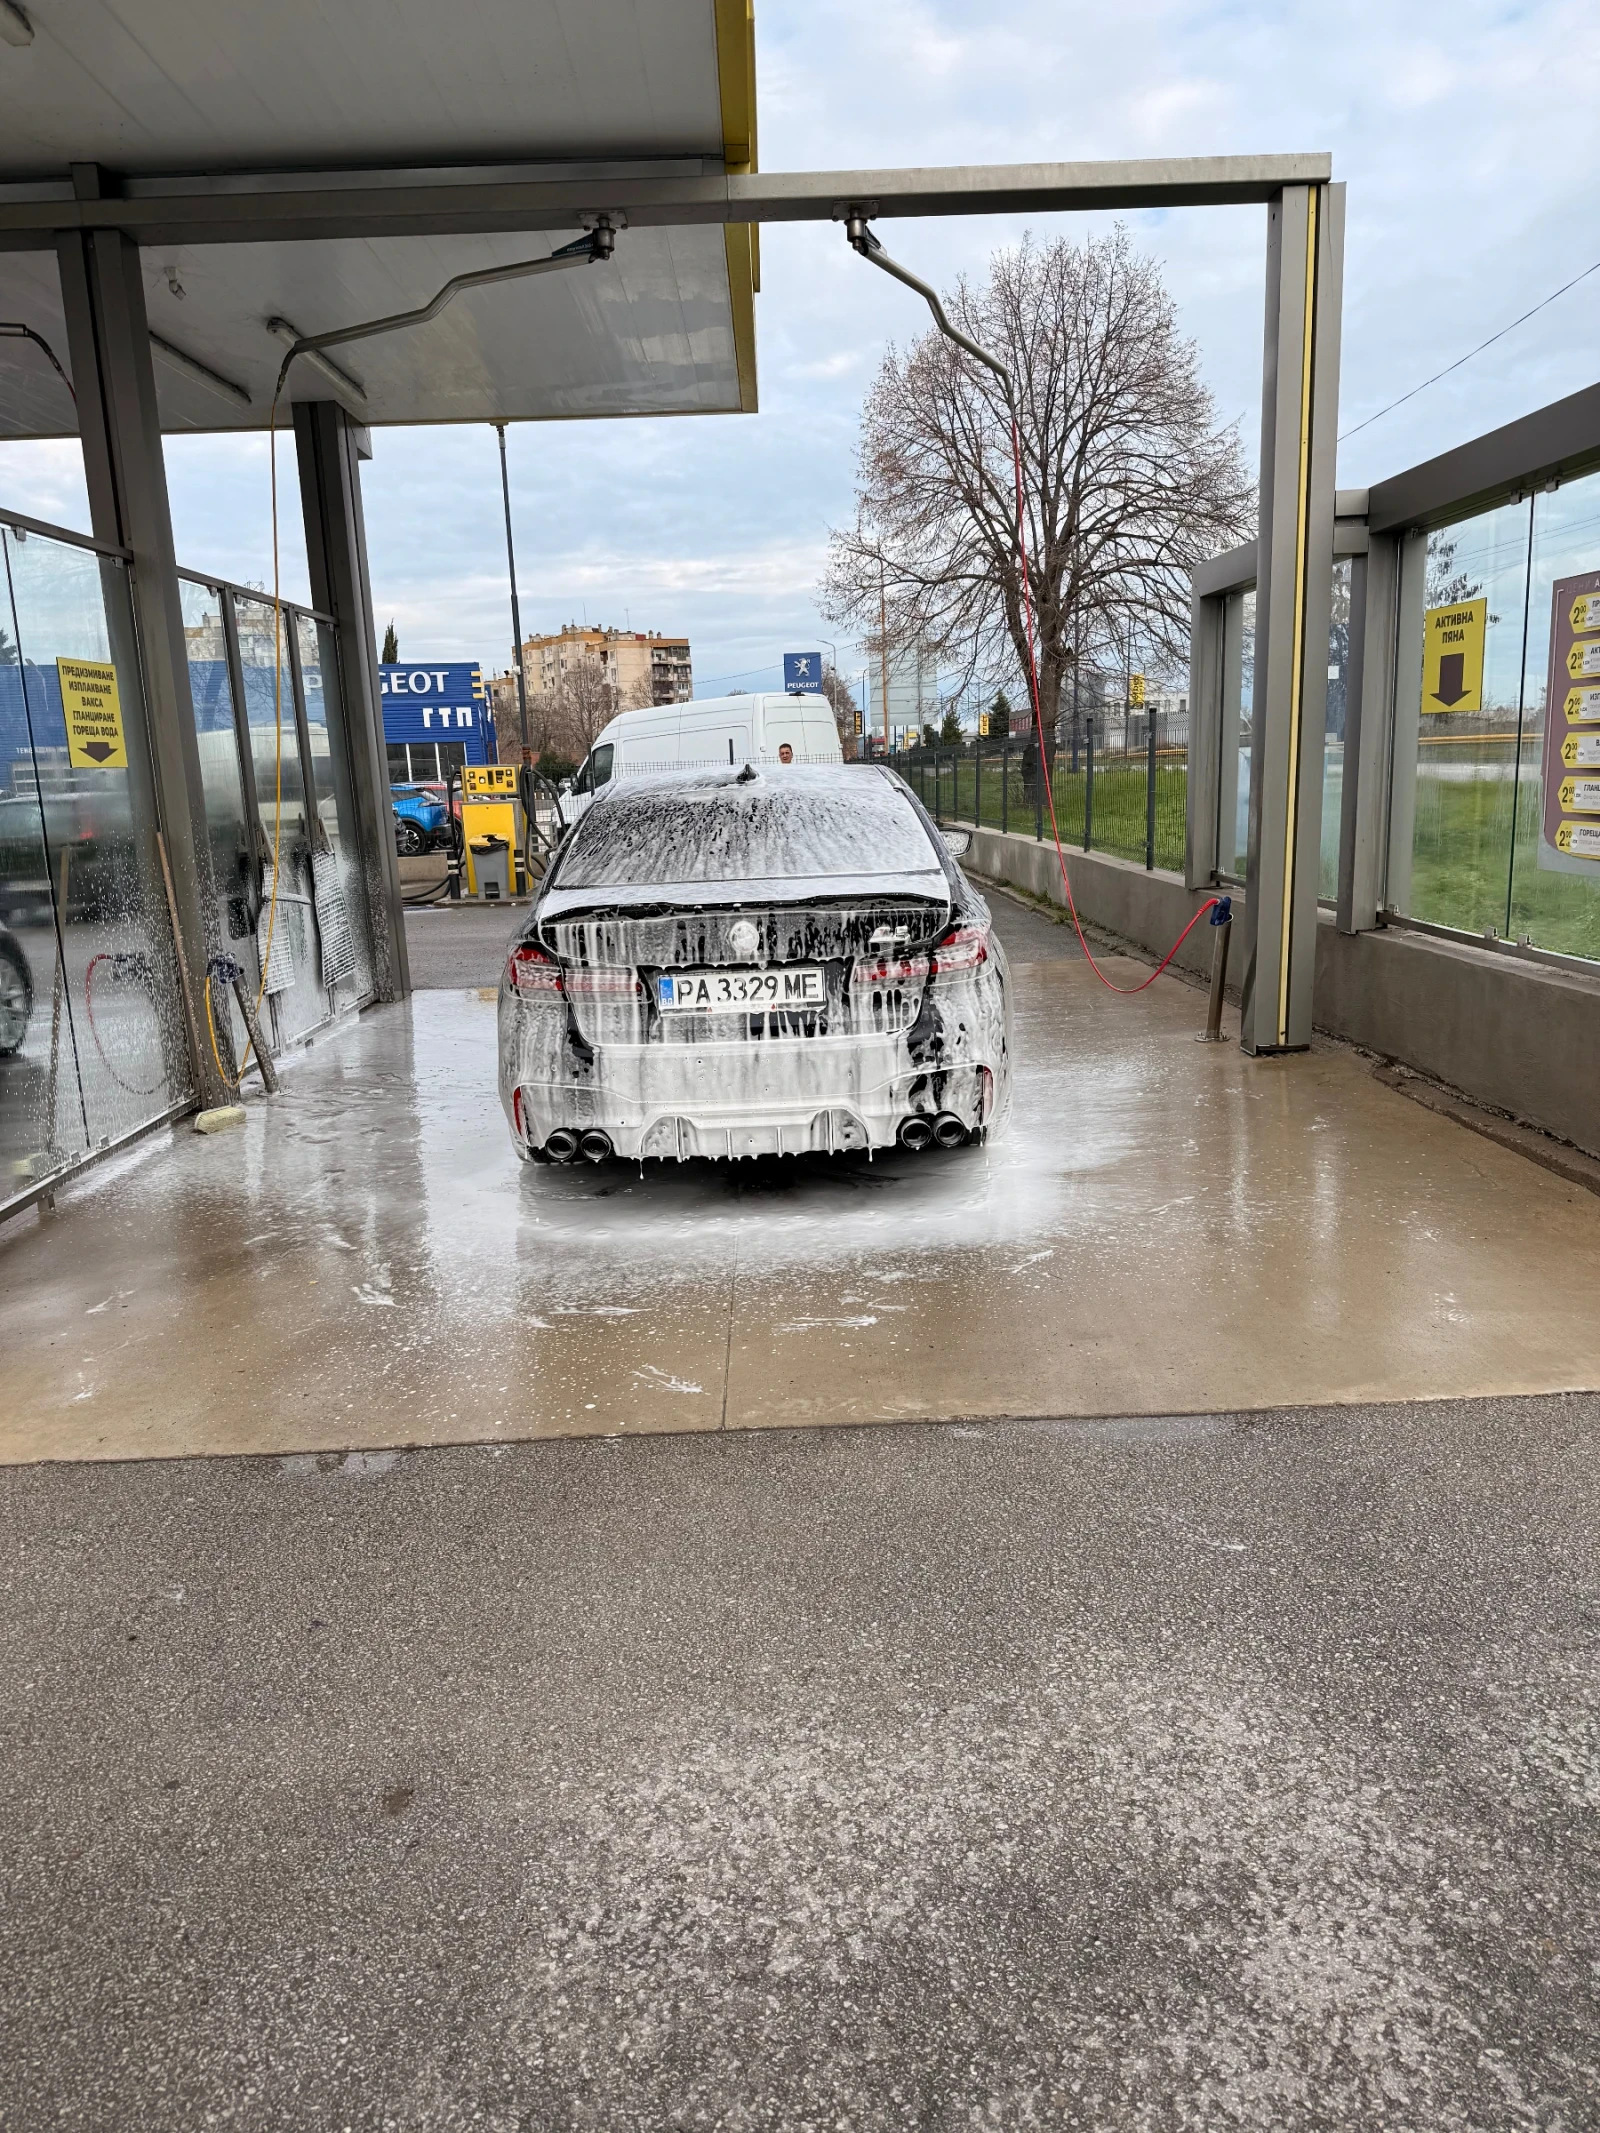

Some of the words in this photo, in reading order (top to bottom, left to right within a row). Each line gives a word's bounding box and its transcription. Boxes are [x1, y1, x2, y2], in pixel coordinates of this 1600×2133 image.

[1435, 611, 1474, 629] АКТИВНА
[1442, 629, 1464, 644] ПЯНА
[61, 665, 114, 681] ПРЕДИЗМИВАНЕ
[68, 680, 112, 695] ИЗПЛАКВАНЕ
[81, 696, 104, 708] ВАКСА
[72, 710, 115, 723] ГЛАНЦИРАНЕ
[422, 707, 473, 728] ГТП
[72, 725, 100, 737] ГОРЕЩА
[101, 725, 119, 738] ВОДА
[677, 979, 711, 1005] PA
[717, 975, 778, 1002] 3329
[784, 973, 819, 1000] ME
[662, 998, 673, 1006] BG
